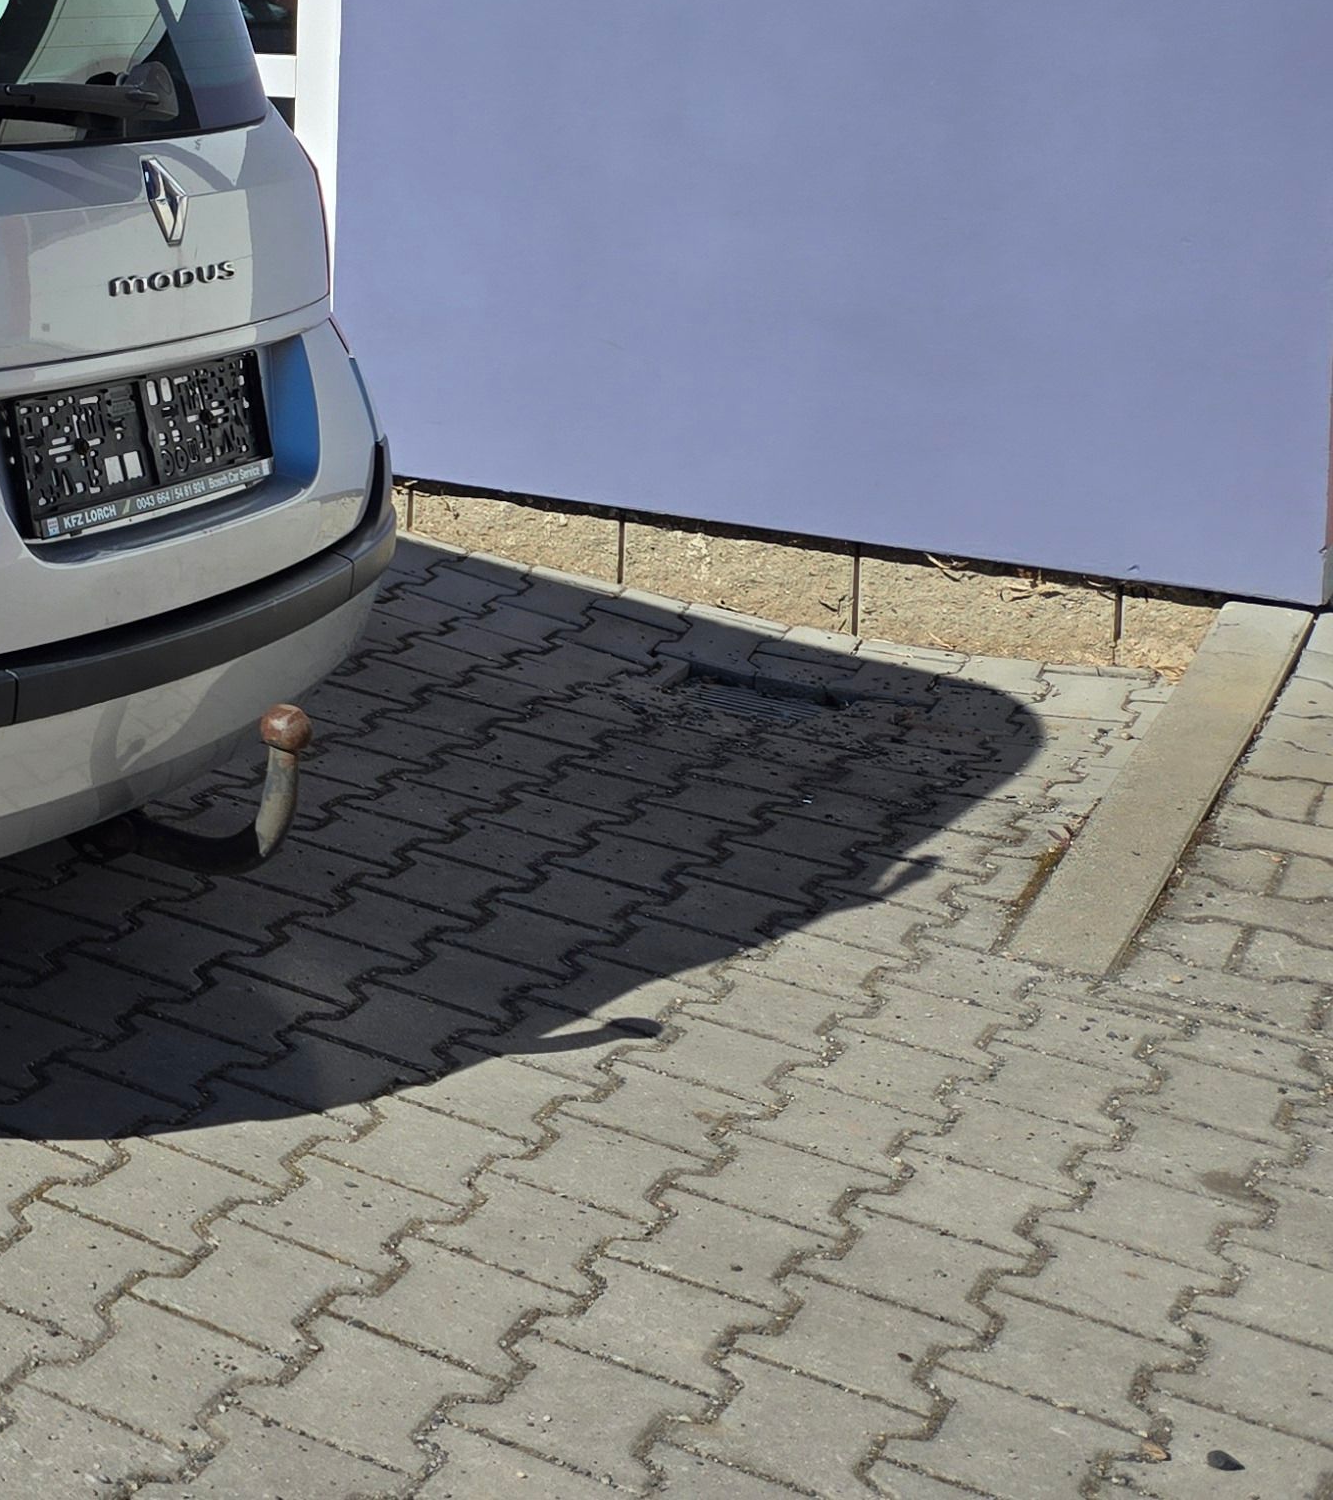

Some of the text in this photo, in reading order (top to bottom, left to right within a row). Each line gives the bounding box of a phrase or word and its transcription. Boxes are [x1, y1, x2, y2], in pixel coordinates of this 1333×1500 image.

[62, 514, 85, 529] KFZ
[85, 504, 117, 524] LORCH
[135, 494, 155, 510] 0043
[239, 465, 262, 481] Service
